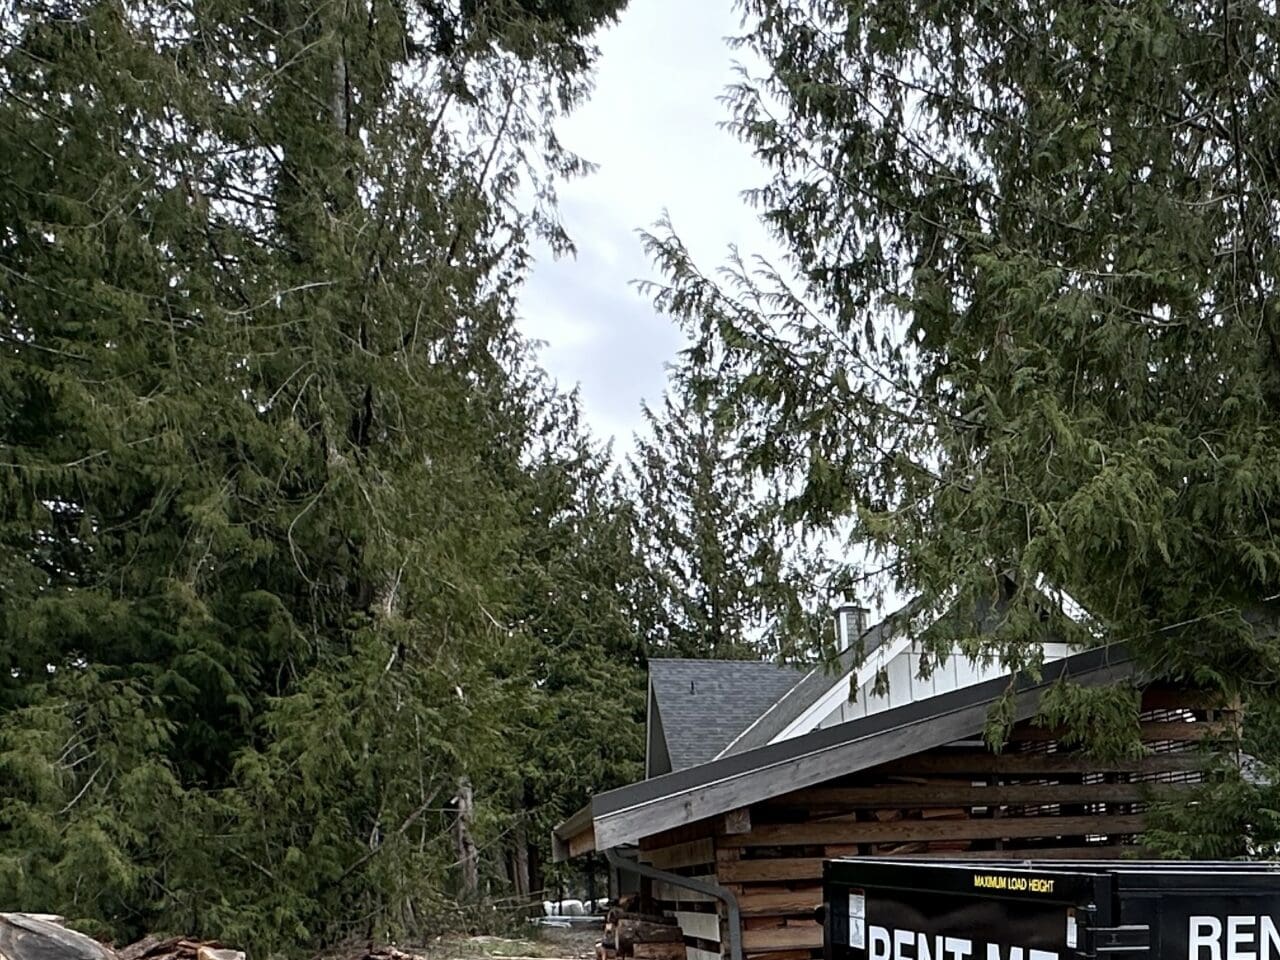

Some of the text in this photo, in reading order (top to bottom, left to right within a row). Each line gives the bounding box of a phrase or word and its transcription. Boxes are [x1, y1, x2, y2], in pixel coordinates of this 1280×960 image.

[974, 874, 1054, 893] MAXIMUM LOAD HEIGHT
